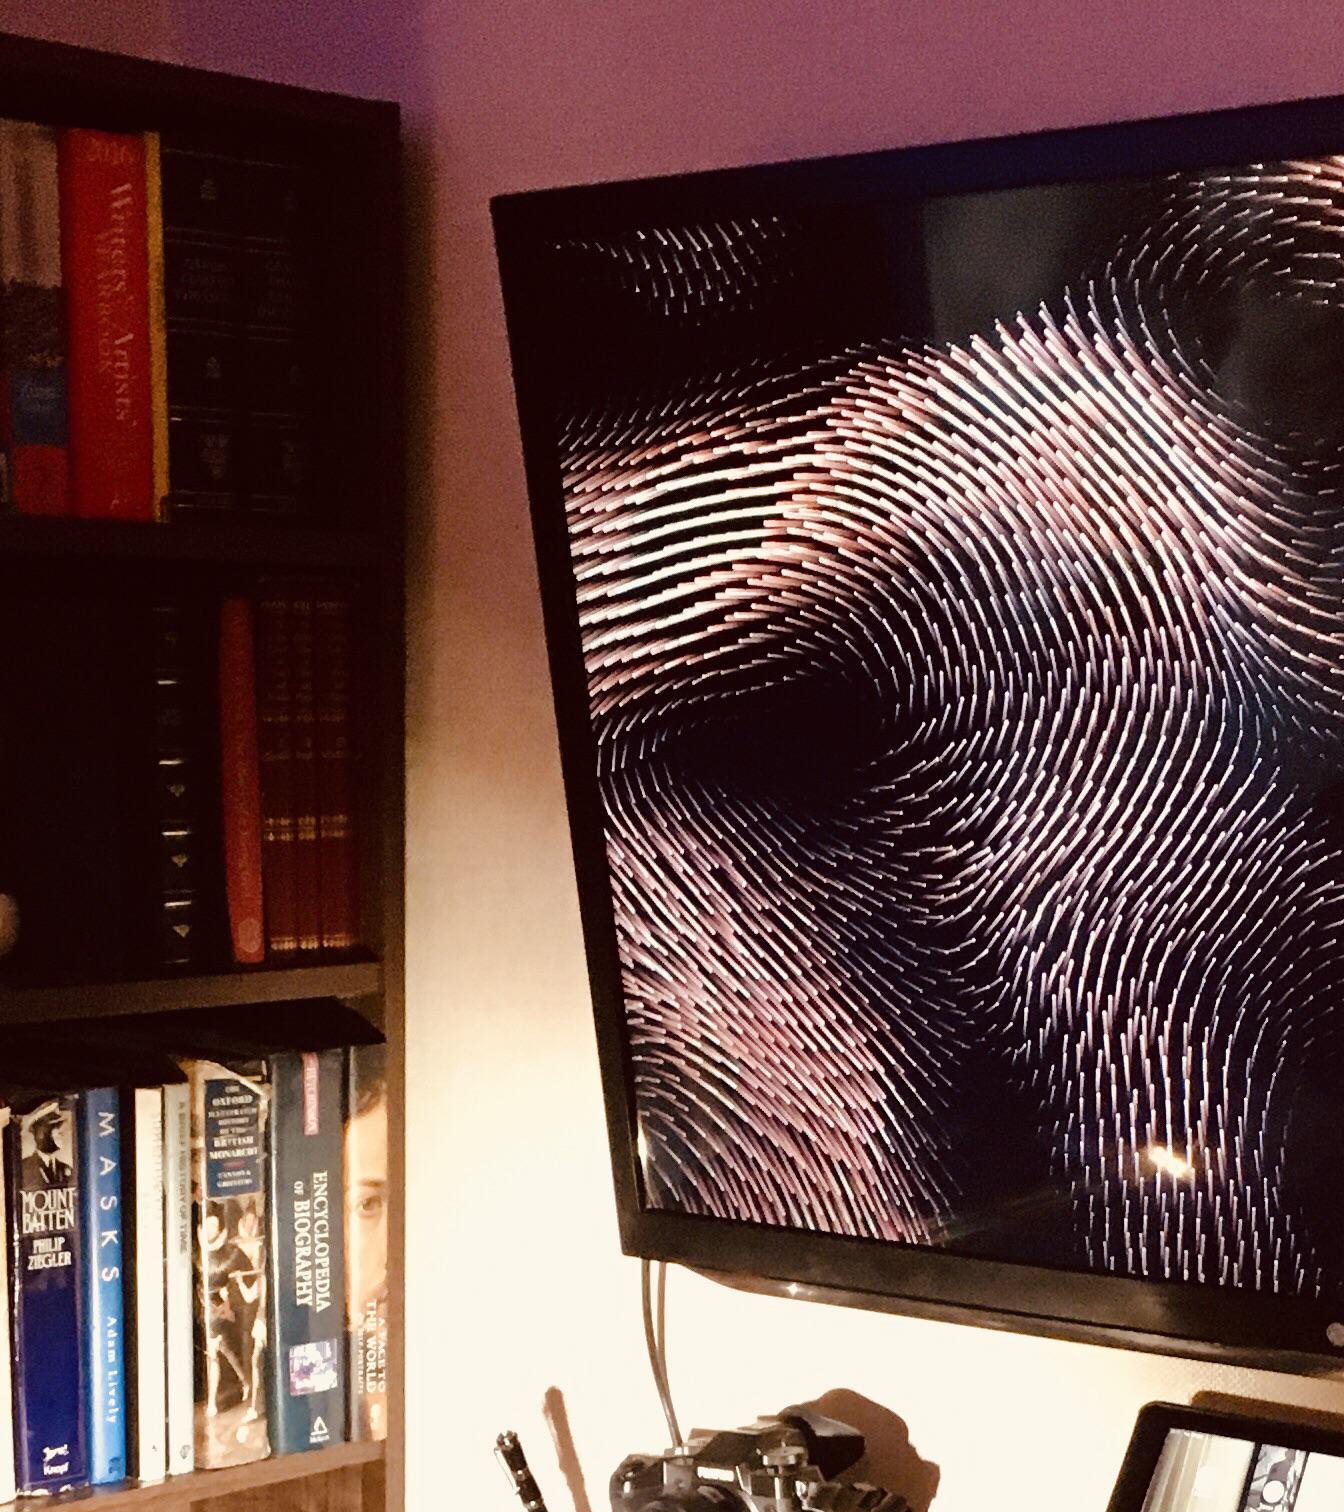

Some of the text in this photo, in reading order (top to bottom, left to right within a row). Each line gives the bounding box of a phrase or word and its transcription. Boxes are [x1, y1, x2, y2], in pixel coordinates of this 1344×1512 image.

[109, 181, 138, 429] Writers' Artists'
[212, 1095, 253, 1106] OXFORD
[209, 1147, 258, 1160] MONARCHY
[214, 1136, 254, 1148] BRITISH
[178, 1150, 188, 1203] HISTORY
[21, 1188, 76, 1213] MOUNT
[97, 1110, 120, 1283] MASKS
[22, 1208, 75, 1235] BATTEN
[32, 1236, 66, 1254] PHILIP
[179, 1224, 188, 1254] TIME
[294, 1181, 312, 1307] OF BIOGRAPHY
[312, 1171, 329, 1314] ENCYCLOPEDIA
[27, 1251, 72, 1271] ZIEGLER
[365, 1299, 377, 1393] THE WORLD
[105, 1317, 120, 1425] Adam Lively
